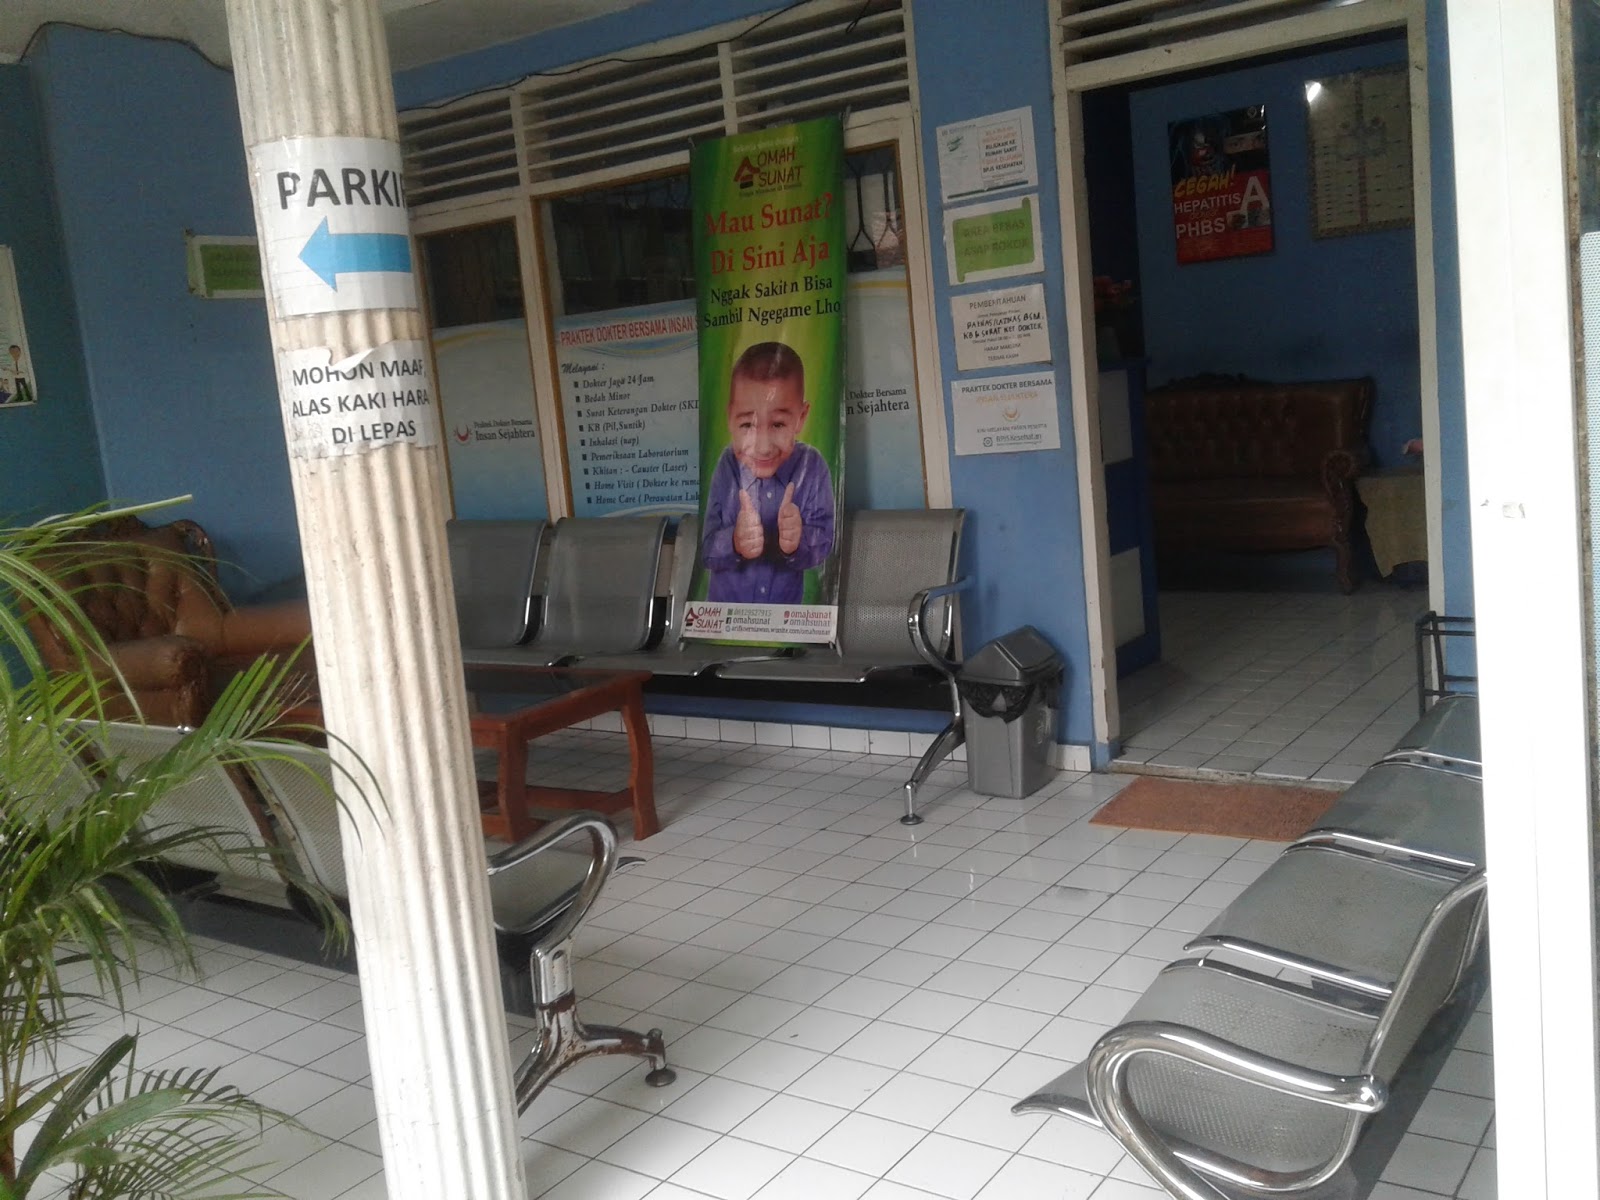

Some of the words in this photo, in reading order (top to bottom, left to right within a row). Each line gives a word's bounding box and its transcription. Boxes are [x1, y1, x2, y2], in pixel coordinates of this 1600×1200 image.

[757, 146, 795, 166] OMAH
[759, 166, 804, 188] SUNAT
[1174, 163, 1236, 198] CEGAH!
[1174, 192, 1242, 215] HEPATITIS
[706, 211, 754, 236] Mau
[761, 192, 833, 229] Sunat?
[1175, 217, 1226, 239] PHBS
[711, 248, 734, 275] Di
[742, 241, 785, 271] Sini
[792, 235, 829, 269] Aja
[711, 285, 750, 307] Nggak
[755, 279, 788, 299] Sakit
[803, 275, 833, 291] Bisa
[704, 306, 742, 328] Sambil
[748, 304, 812, 326] Ngegame
[816, 298, 840, 315] Lho
[560, 329, 595, 346] PRAKTEK
[596, 323, 628, 341] DOKTER
[628, 317, 667, 338] BERSAMA
[668, 316, 694, 333] INSAN
[561, 362, 599, 376] Melayani
[583, 379, 606, 389] Dokter
[609, 378, 625, 389] Jaga
[627, 375, 636, 384] 24
[638, 374, 655, 386] Jam
[961, 384, 991, 393] PRAKTEK
[992, 381, 1018, 391] DOKTER
[1019, 379, 1052, 388] BERSAMA
[584, 394, 606, 403] Bedah
[608, 392, 630, 401] Minor
[850, 389, 875, 399] Dokter
[876, 388, 907, 398] Bersama
[292, 396, 332, 419] ALAS
[338, 392, 386, 413] KAKI
[586, 408, 606, 418] Surat
[608, 406, 648, 418] Keterangan
[651, 403, 677, 413] Dokter
[857, 398, 910, 417] Sejahtera
[331, 425, 353, 445] DI
[361, 419, 417, 442] LEPAS
[475, 431, 498, 441] Insan
[498, 427, 535, 442] Sejahtera
[588, 424, 601, 433] KB
[589, 437, 618, 446] Inhalasi
[1010, 433, 1042, 442] Kesehatan
[591, 451, 637, 462] Pemeriksaan
[638, 448, 689, 459] Laboratorium
[592, 465, 618, 475] Khitan
[662, 463, 688, 474] (Laser)
[594, 481, 615, 490] Home
[617, 479, 634, 489] Visit
[642, 478, 668, 489] Dokter
[670, 476, 679, 486] ke
[596, 495, 616, 504] Home
[618, 493, 636, 503] Care
[644, 493, 683, 503] Perawatan
[698, 606, 722, 617] OMAH
[791, 610, 831, 620] omahsunat
[695, 618, 724, 630] SUNAT
[733, 616, 770, 626] omahsunat
[789, 618, 831, 627] omahsunat
